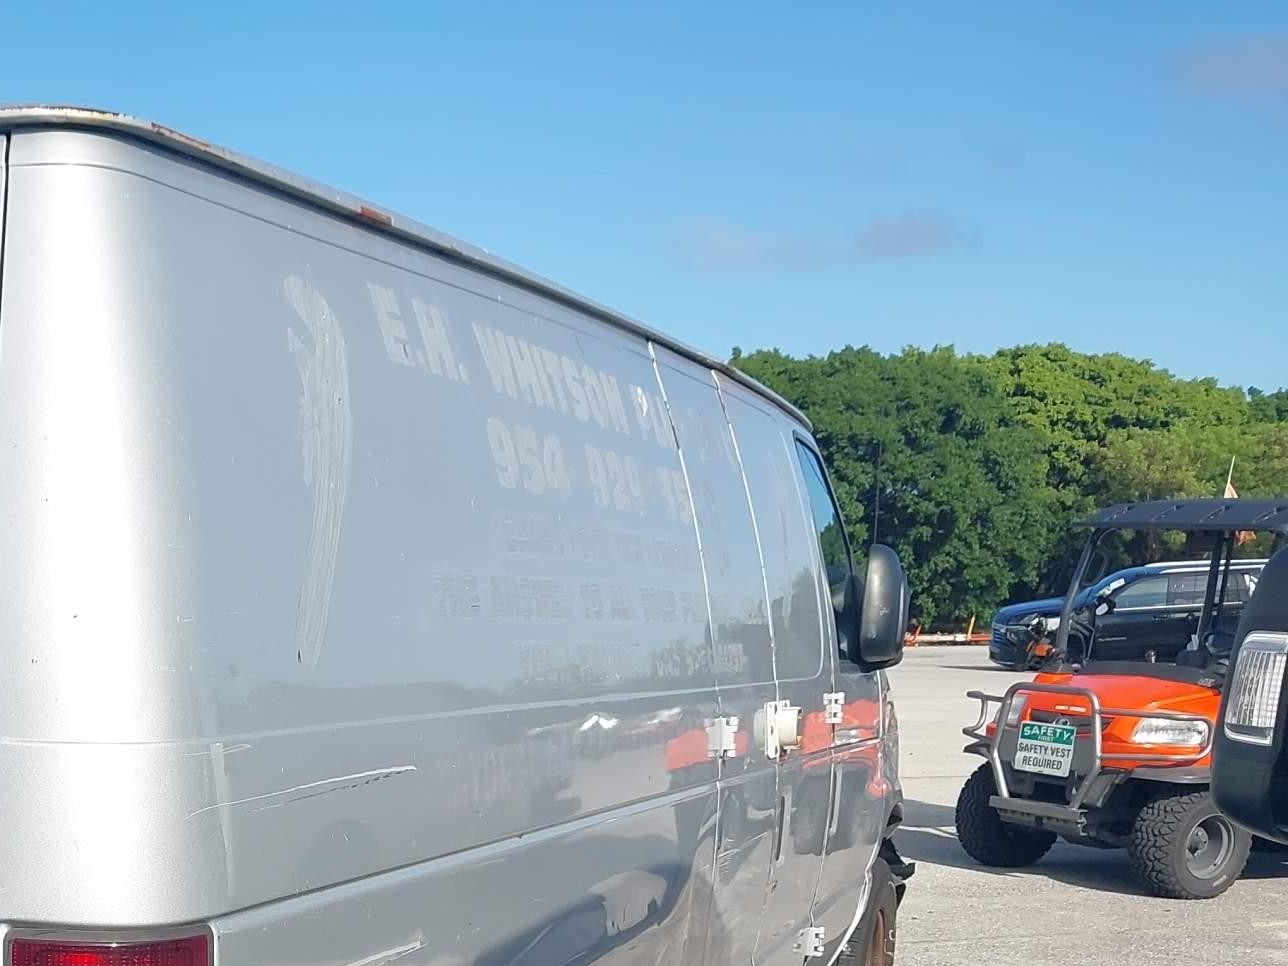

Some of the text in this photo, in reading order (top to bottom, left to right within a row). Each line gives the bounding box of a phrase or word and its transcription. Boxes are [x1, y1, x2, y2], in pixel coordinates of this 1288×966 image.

[366, 281, 470, 385] E.H.
[471, 320, 630, 435] WHITSON
[487, 417, 571, 498] 954
[1023, 725, 1071, 740] SAFETY
[1018, 742, 1071, 758] SAFETY VEST
[1022, 755, 1062, 770] REQUIRED
